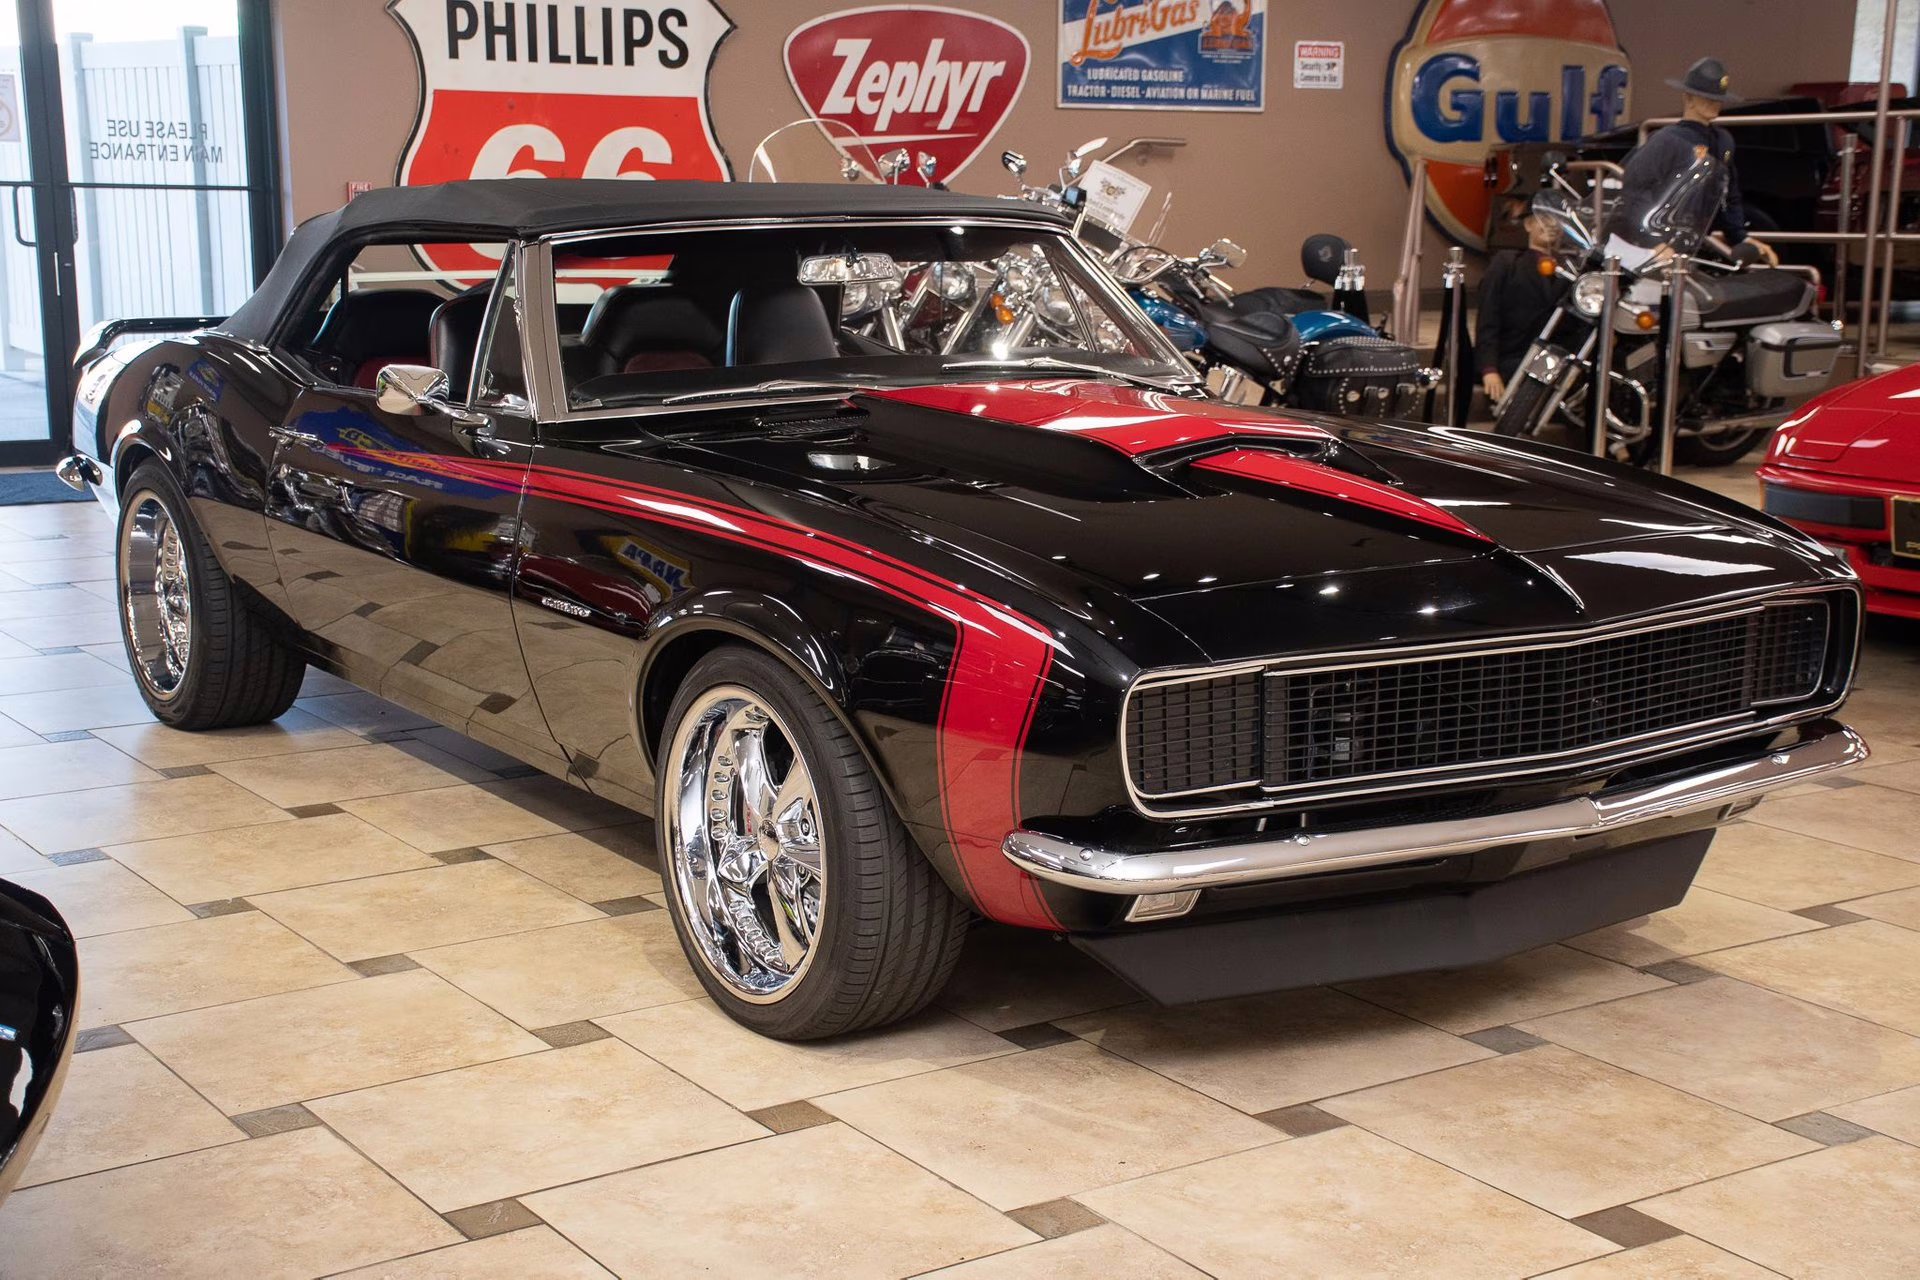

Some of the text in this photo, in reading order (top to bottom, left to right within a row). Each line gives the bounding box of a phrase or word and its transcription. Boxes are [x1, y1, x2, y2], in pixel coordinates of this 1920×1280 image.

[446, 0, 689, 69] PHILLIPS
[1299, 46, 1340, 58] WARNING
[819, 38, 1007, 132] Zephyr
[1087, 67, 1184, 82] LUBRICATED GASOLINE
[1186, 88, 1199, 100] OR
[1200, 88, 1235, 101] MARINE
[1235, 89, 1257, 102] FUEL
[1411, 52, 1629, 144] Gulf
